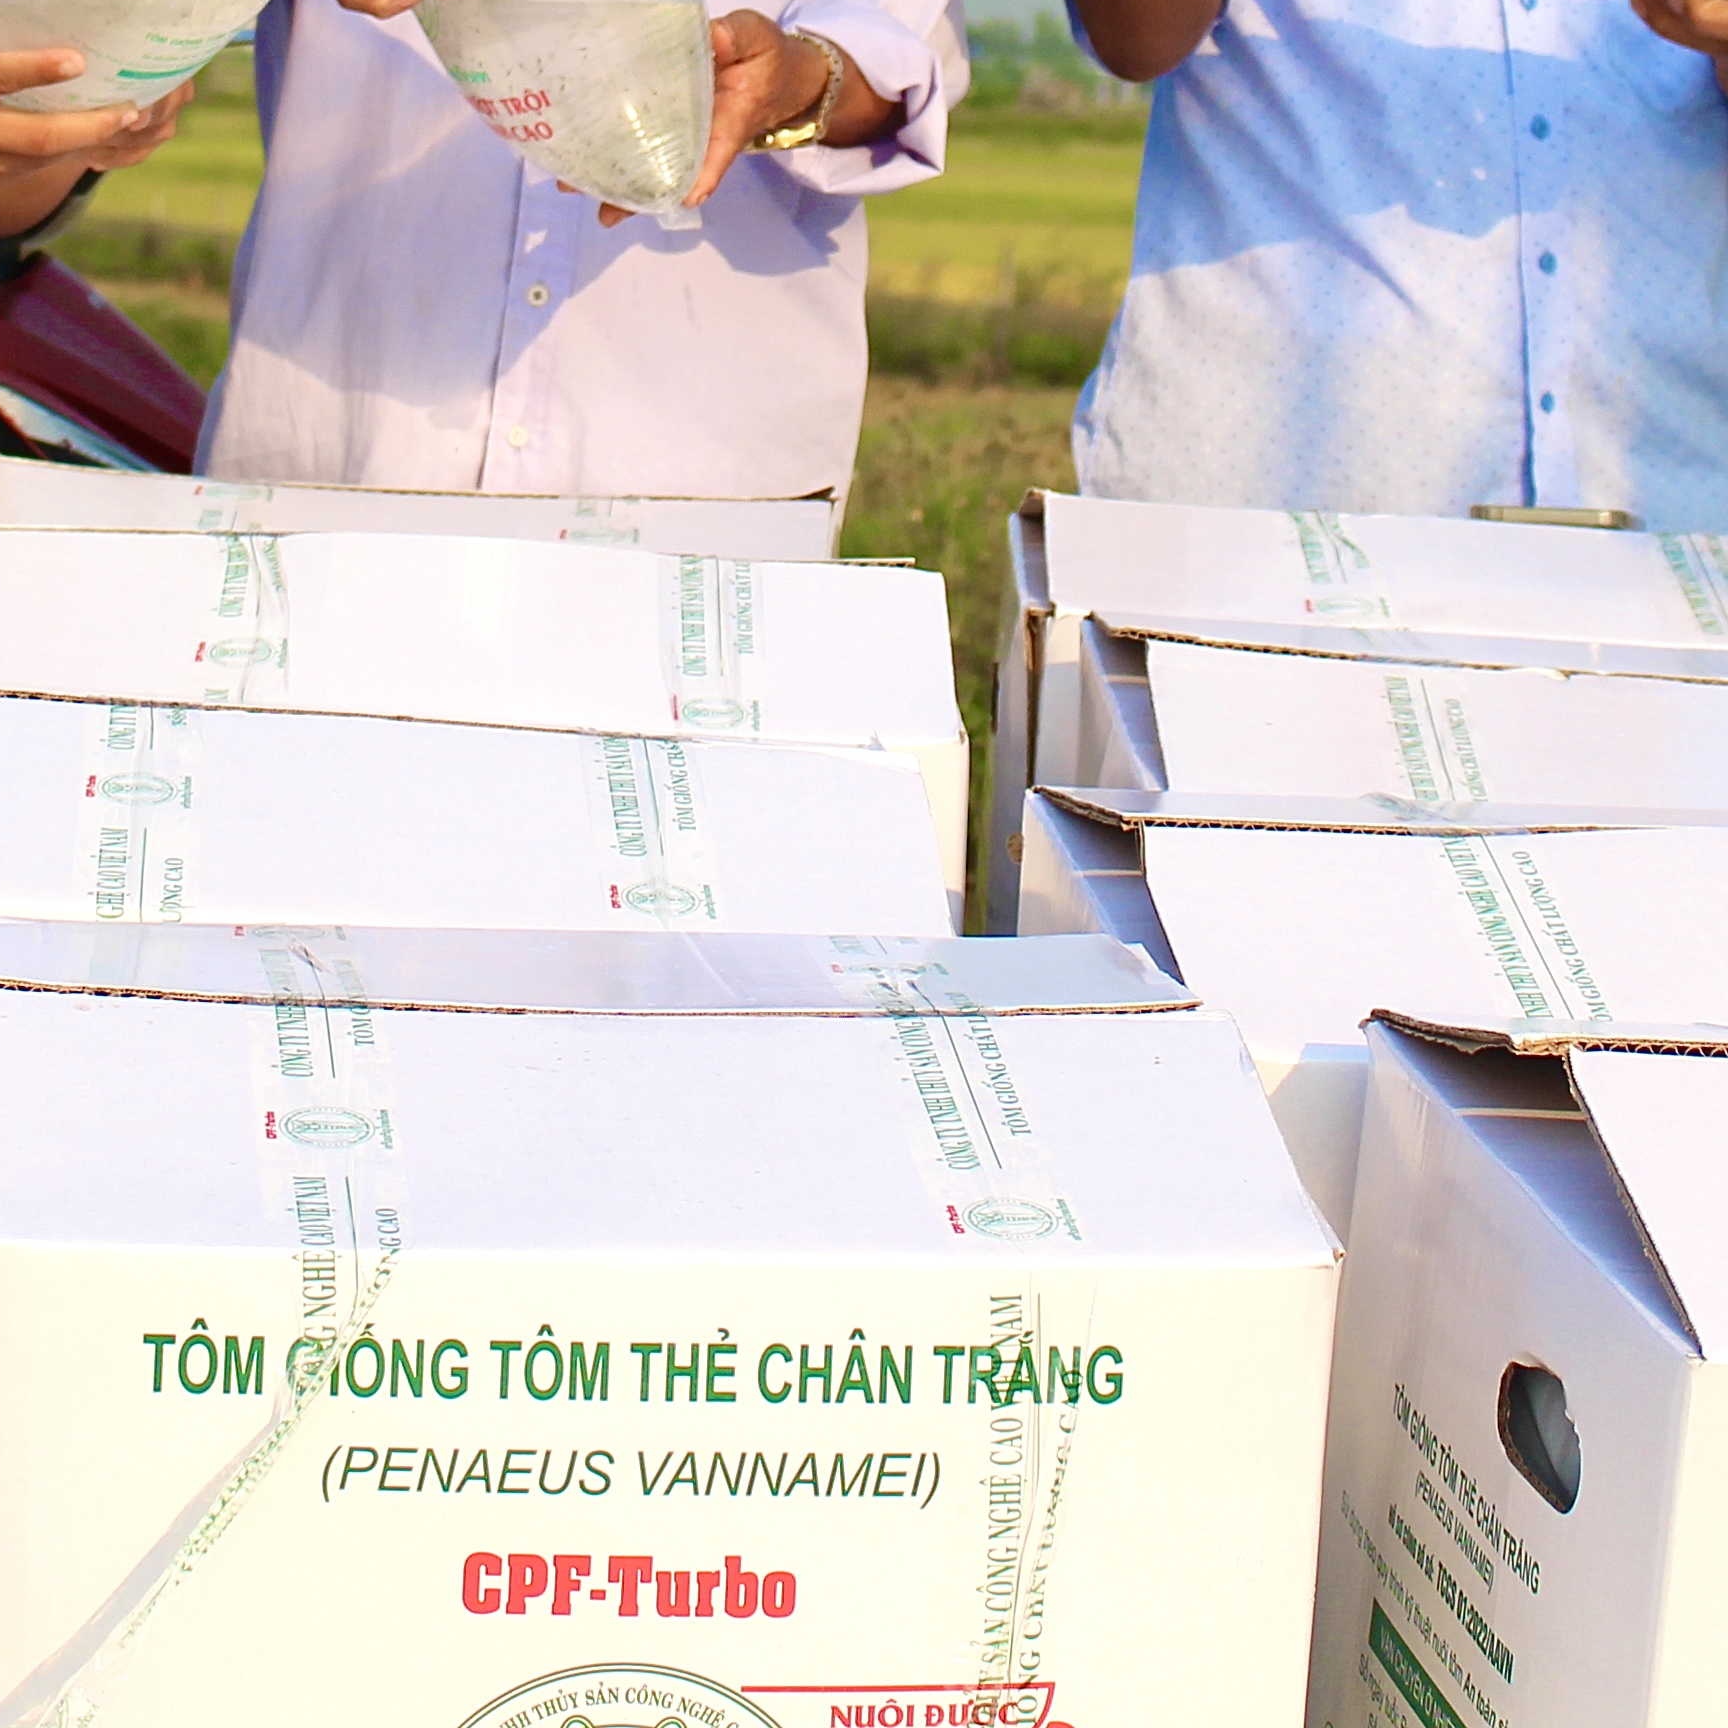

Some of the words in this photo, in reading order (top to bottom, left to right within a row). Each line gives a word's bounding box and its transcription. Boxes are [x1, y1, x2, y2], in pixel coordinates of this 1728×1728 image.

[499, 88, 552, 117] TRỘI
[164, 857, 184, 881] CAO
[1511, 850, 1539, 876] CAO
[87, 890, 131, 920] GHỆ
[1541, 920, 1579, 956] CHẤT
[347, 1018, 376, 1047] TÔM
[962, 1025, 1002, 1060] CHẤT
[270, 1049, 315, 1077] CÔNG
[981, 1062, 1020, 1105] GIỐNG
[1001, 1106, 1032, 1137] TÔM
[298, 1224, 336, 1246] CAO
[374, 1207, 400, 1235] CAO
[292, 1249, 342, 1318] NGHỆ
[989, 1293, 1024, 1359] NAM
[142, 1317, 266, 1395] TÔM
[489, 1323, 611, 1401] TÔM
[629, 1327, 738, 1403] THẺ
[757, 1327, 915, 1404] CHÂN
[933, 1329, 1125, 1405] TRẮNG
[989, 1416, 1025, 1467] CAO
[321, 1445, 616, 1503] (PENAEUS
[636, 1451, 942, 1510] VANNAMEI)
[1393, 1382, 1411, 1431] TÔM
[1438, 1442, 1459, 1494] TÔM
[1475, 1495, 1503, 1553] CHÂN
[979, 1473, 1028, 1541] NGHỆ
[461, 1552, 798, 1619] CPF-Turbo
[975, 1544, 1020, 1613] CÔNG
[530, 1688, 579, 1721] THỦY
[585, 1680, 621, 1706] SẢN
[624, 1683, 675, 1709] CÔNG
[1462, 1672, 1477, 1704] An
[830, 1698, 916, 1728] NUÔI
